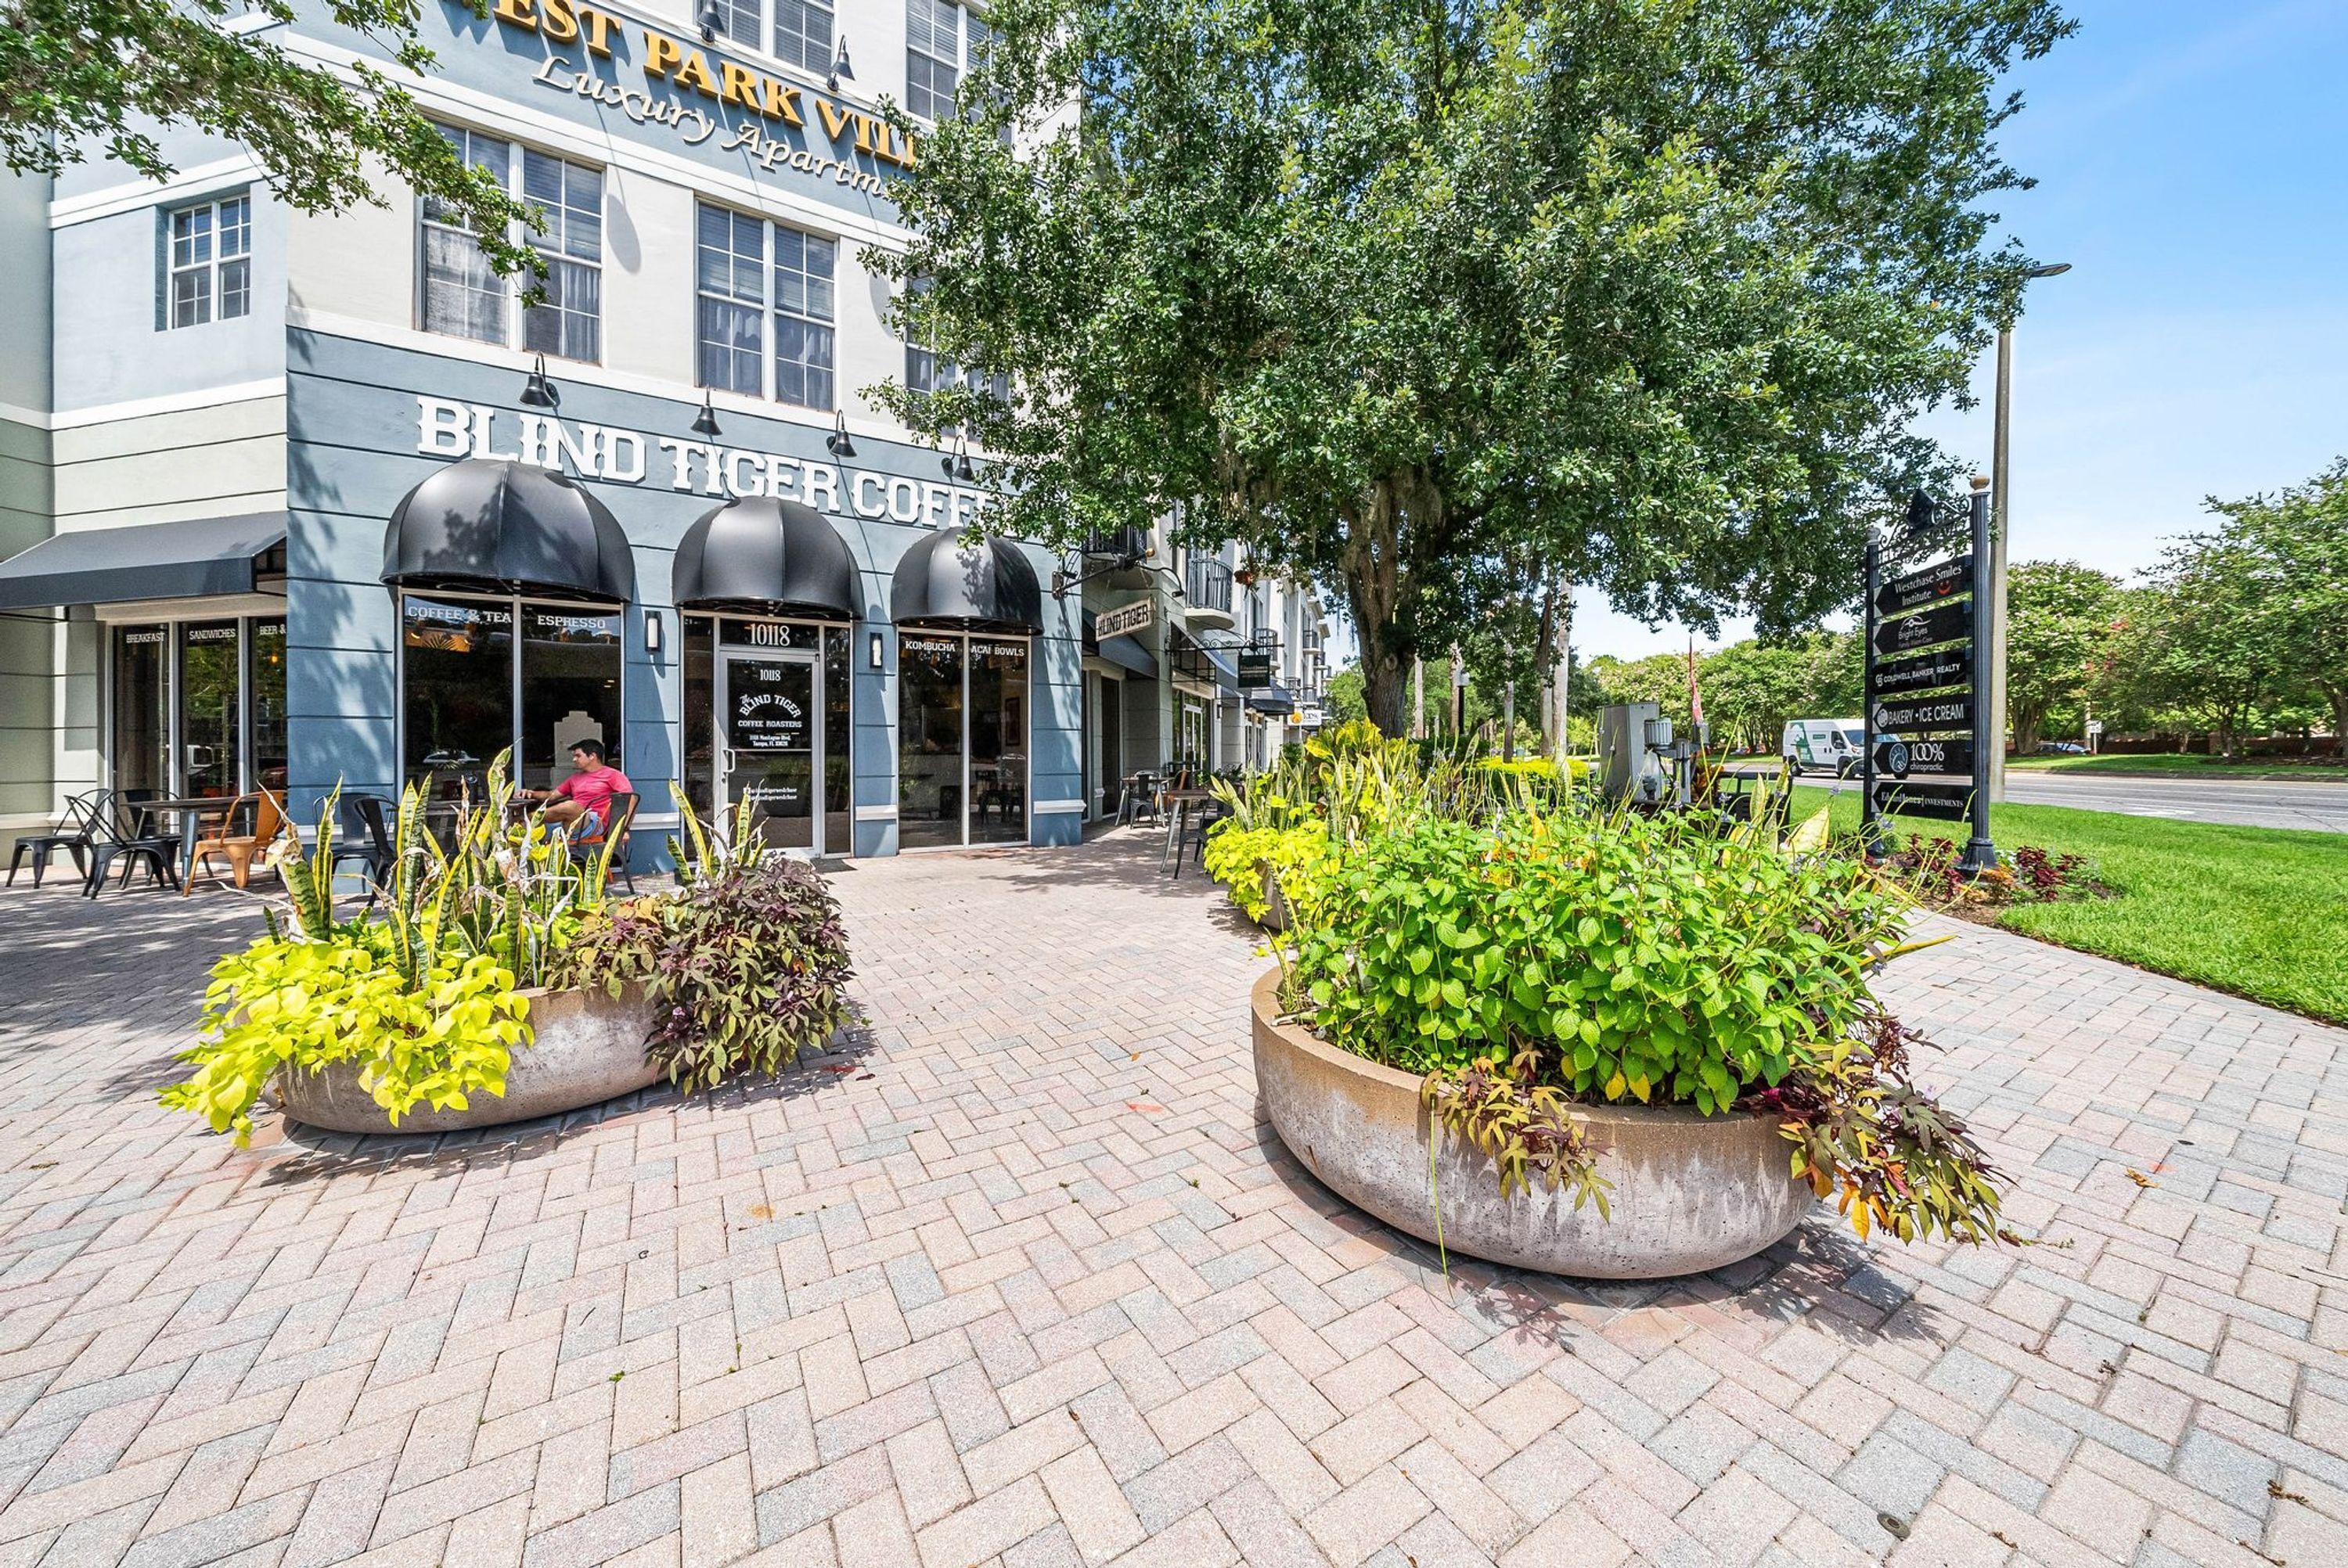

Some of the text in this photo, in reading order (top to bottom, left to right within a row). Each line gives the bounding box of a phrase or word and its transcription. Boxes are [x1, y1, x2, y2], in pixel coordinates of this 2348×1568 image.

[460, 0, 917, 170] EST PARK VILL
[531, 55, 885, 198] Luxury Apartm
[416, 395, 995, 528] BLIND TIGER COFF
[1895, 564, 1962, 595] Westchase Smiles
[1902, 589, 1932, 607] Institute
[408, 606, 512, 624] COFFEE & TEA
[537, 615, 606, 628] ESPRESSO
[1098, 603, 1149, 637] BLIND TIGER
[126, 631, 165, 644] BREAKFAST
[189, 628, 236, 640] SANDWICHES
[259, 625, 278, 635] BEER
[750, 623, 790, 647] 10118
[1898, 625, 1928, 641] Bright Eyes
[905, 640, 956, 653] KOMBUCHA
[994, 646, 1025, 657] BOWLS
[759, 669, 781, 682] 10118
[1883, 671, 1911, 683] COLDWELL
[1912, 667, 1934, 678] BANKER
[1936, 663, 1961, 674] REALTY
[739, 694, 801, 718] BLIND TIGER
[1889, 703, 1964, 725] BAKERY ICE CREAM
[738, 719, 764, 728] COFFEE
[1910, 743, 1945, 761] 100%
[1925, 797, 1964, 808] INVESTMENTS
